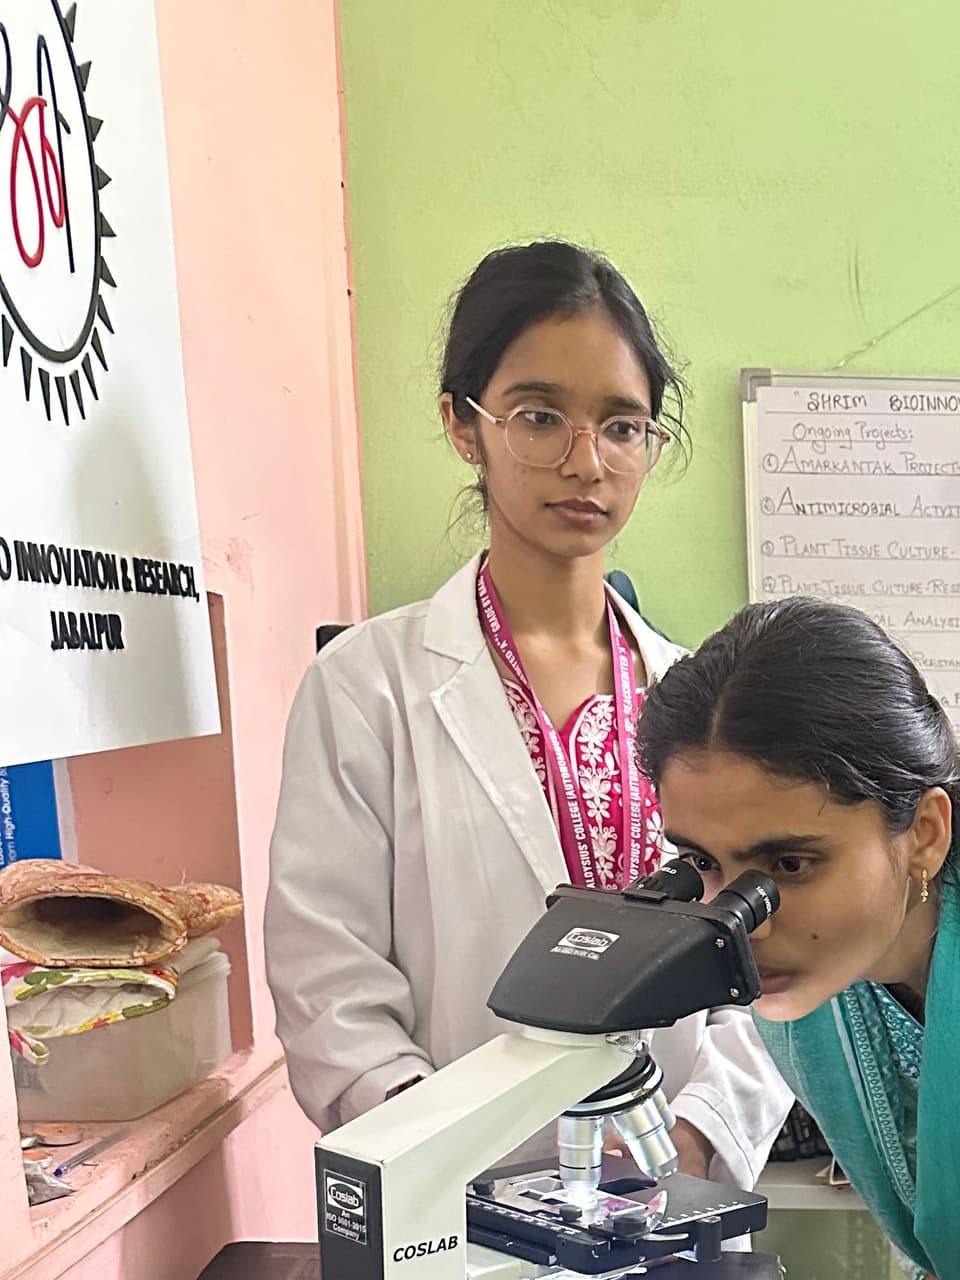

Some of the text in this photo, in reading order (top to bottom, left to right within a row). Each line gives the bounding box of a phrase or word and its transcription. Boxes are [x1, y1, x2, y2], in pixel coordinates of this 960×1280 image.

[793, 423, 852, 455] Ongoing
[777, 486, 900, 516] ANTIMICROBIAL
[13, 540, 120, 590] INNOVATION
[120, 557, 133, 592] &
[50, 610, 125, 651] JABALPUR
[568, 800, 586, 839] COLLEGE
[630, 800, 641, 838] COLLEGE
[568, 932, 609, 947] Coslab
[330, 1185, 359, 1207] Coslab
[393, 1235, 458, 1262] COSLAB
